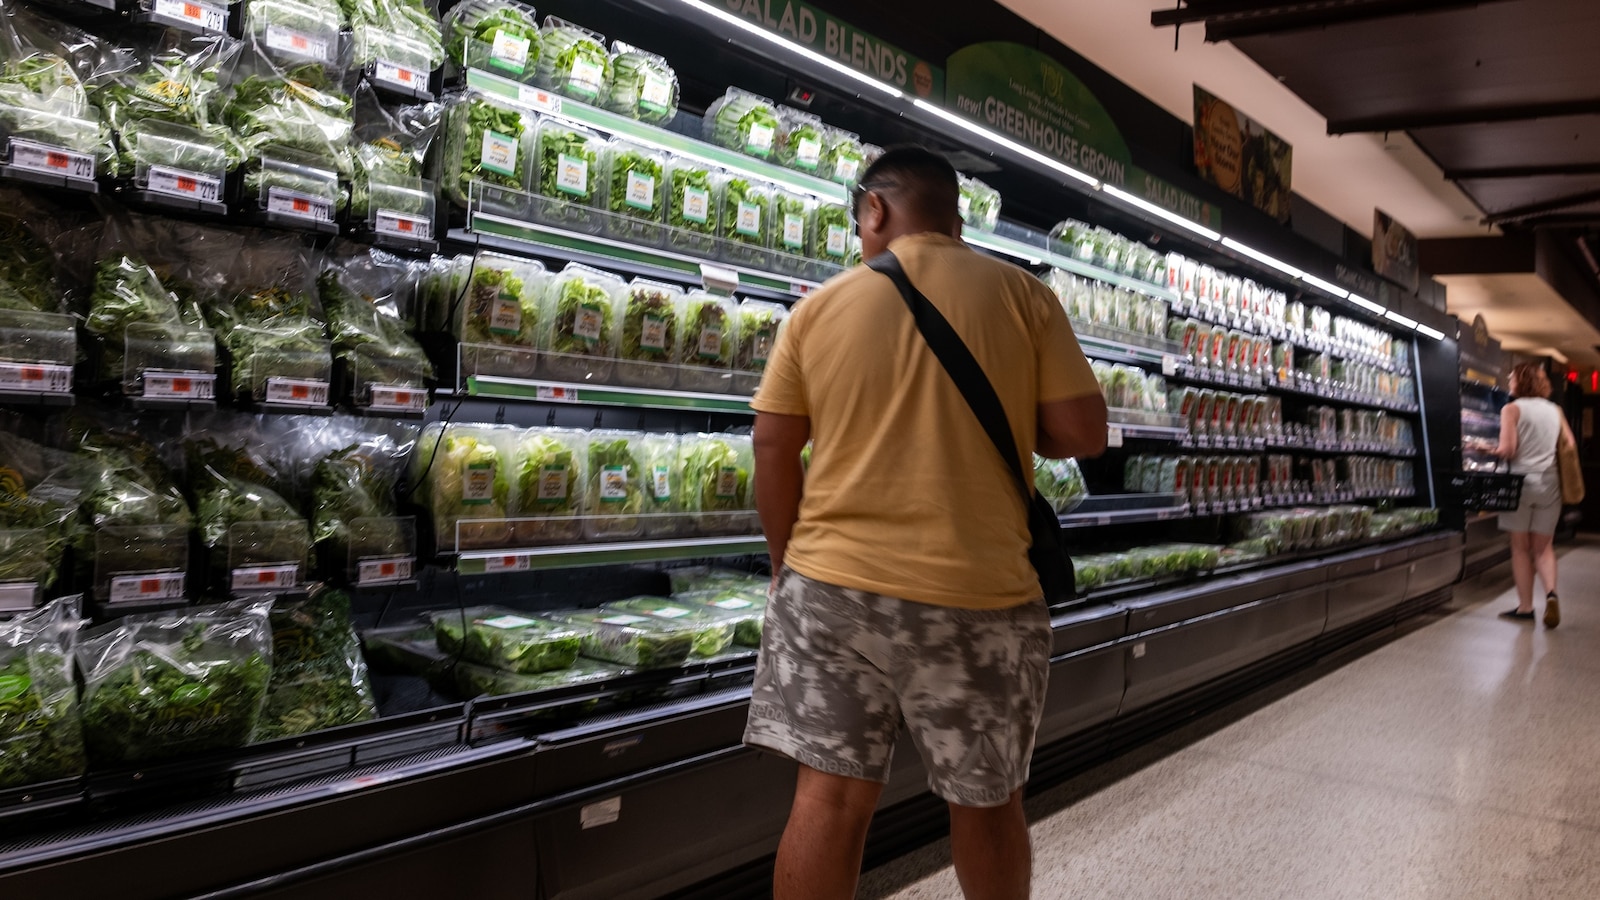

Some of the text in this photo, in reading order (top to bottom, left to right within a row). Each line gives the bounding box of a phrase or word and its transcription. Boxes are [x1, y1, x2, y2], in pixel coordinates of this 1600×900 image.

[826, 19, 907, 87] BLENDS
[957, 95, 1125, 185] new! GREENHOUSE GROWN
[1145, 175, 1200, 221] SALAD KITS
[750, 703, 791, 726] eebok
